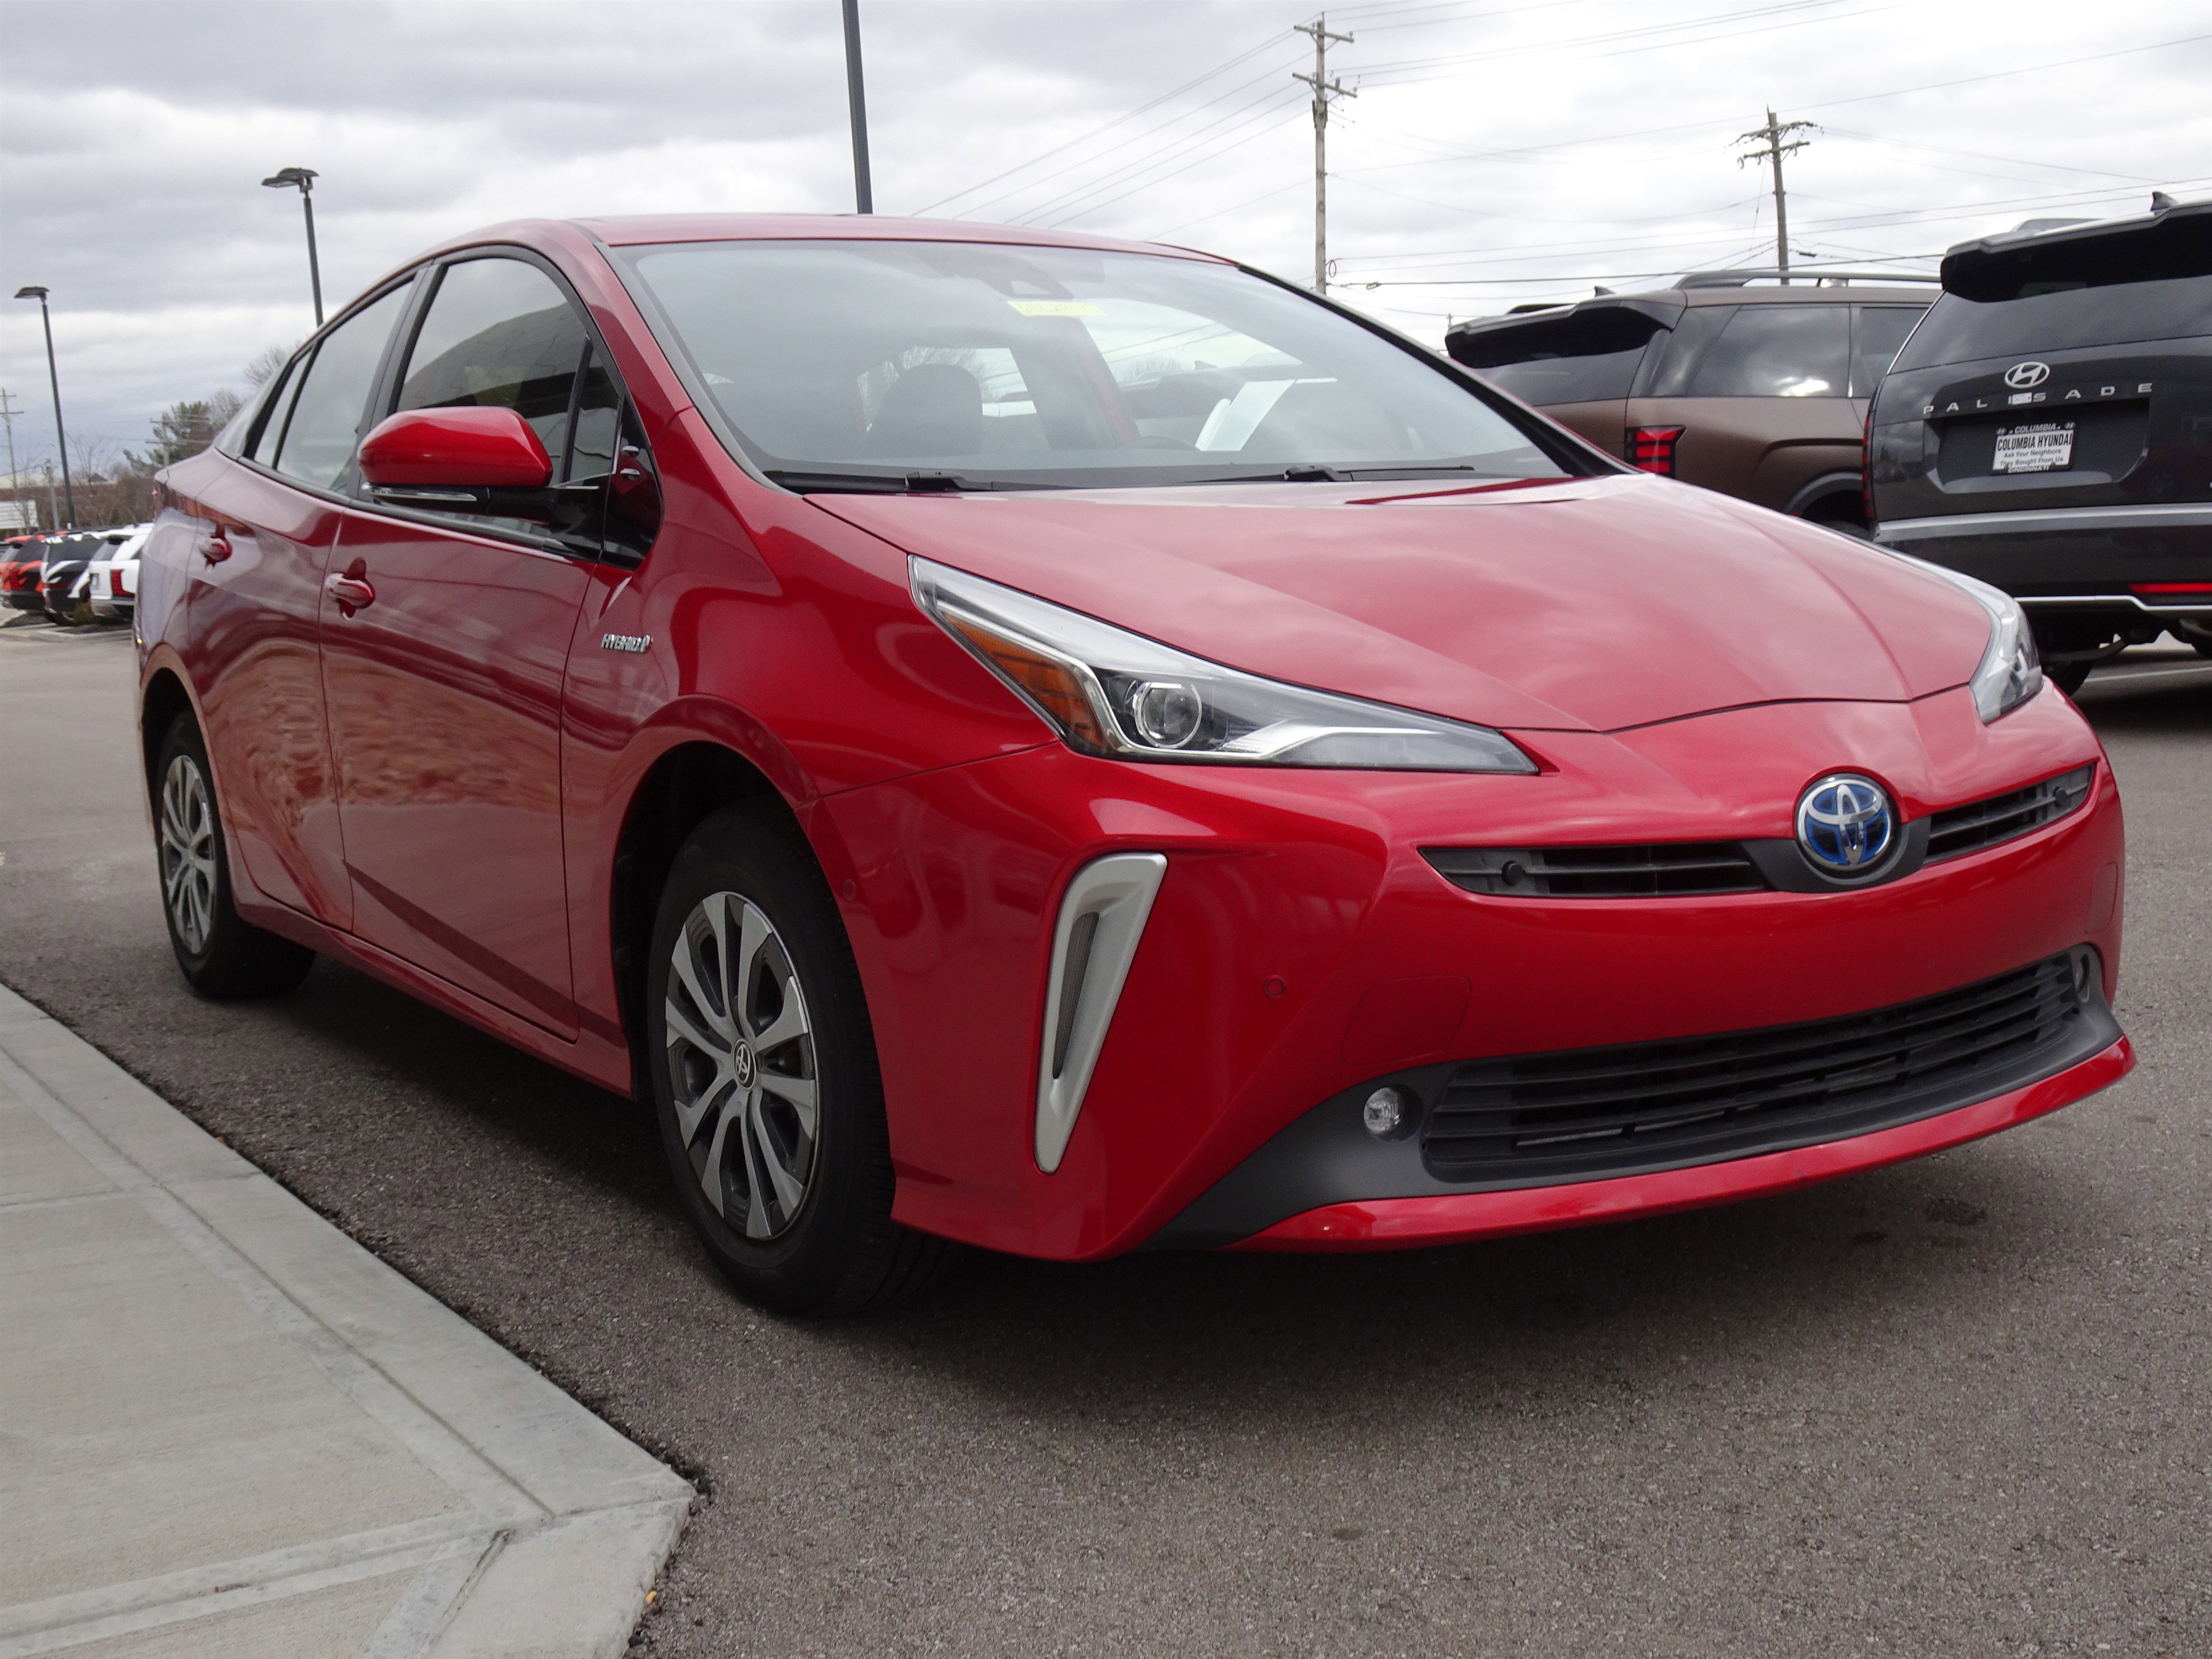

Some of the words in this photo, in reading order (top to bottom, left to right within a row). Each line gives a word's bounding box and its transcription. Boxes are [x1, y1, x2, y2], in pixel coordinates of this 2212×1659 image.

[1924, 382, 2153, 415] PALISADE
[2014, 423, 2056, 434] COLUMBIA
[1998, 436, 2035, 451] COLUMBIA
[2038, 433, 2073, 448] HYUNDAI
[2030, 448, 2062, 457] Neighbors
[2015, 458, 2036, 466] Bought
[601, 633, 642, 652] HYBRID
